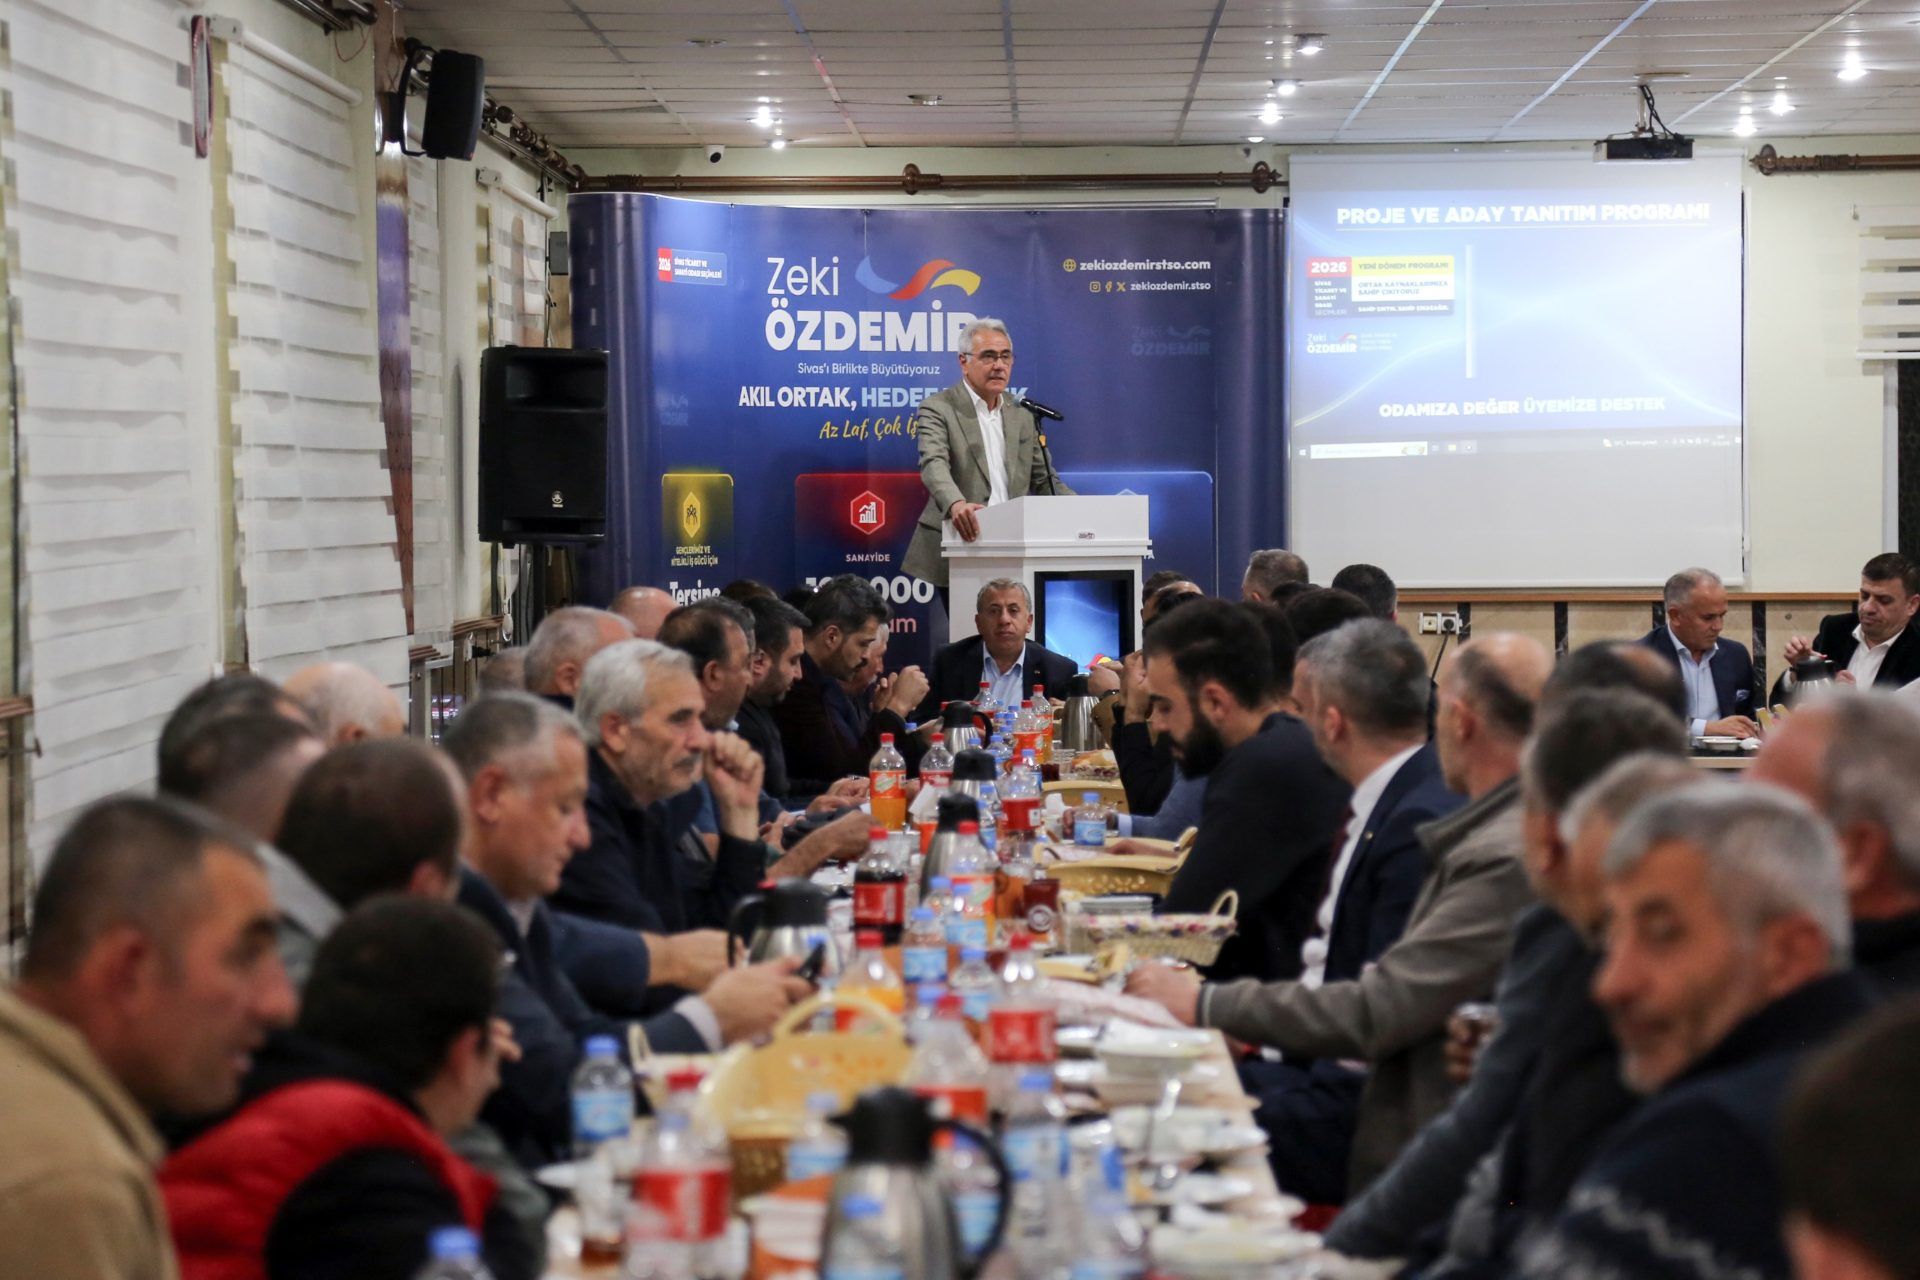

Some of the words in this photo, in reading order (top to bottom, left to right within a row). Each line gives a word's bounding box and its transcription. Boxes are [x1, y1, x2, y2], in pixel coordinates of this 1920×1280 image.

[1336, 207, 1406, 224] PROJE
[1410, 206, 1440, 224] VE
[1444, 205, 1505, 223] ADAY
[1510, 204, 1596, 222] TANITIM
[1601, 203, 1710, 221] PROGRAMI
[1080, 259, 1211, 271] zekiozdemirstso.com
[1311, 261, 1347, 274] 2026
[1378, 261, 1406, 270] DÖNEM
[1407, 261, 1449, 269] PROGRAMI
[767, 256, 839, 296] Zeki
[1130, 280, 1211, 291] zekiozdemir.stso
[1306, 341, 1357, 354] ÖZDEMİR
[798, 363, 830, 375] Sivas'ı
[832, 363, 869, 375] Birlikte
[871, 364, 940, 377] Büyütüyoruz
[738, 386, 775, 407] AKIL
[777, 386, 857, 412] ORTAK,
[1379, 403, 1459, 417] ODAMIZA
[1463, 398, 1519, 415] DEĞER
[1524, 396, 1597, 413] ÜYEMİZE
[1600, 397, 1666, 412] DESTEK
[820, 420, 838, 439] Az
[843, 418, 869, 441] Laf,
[874, 417, 902, 441] Çok
[845, 552, 891, 562] SANAYİDE
